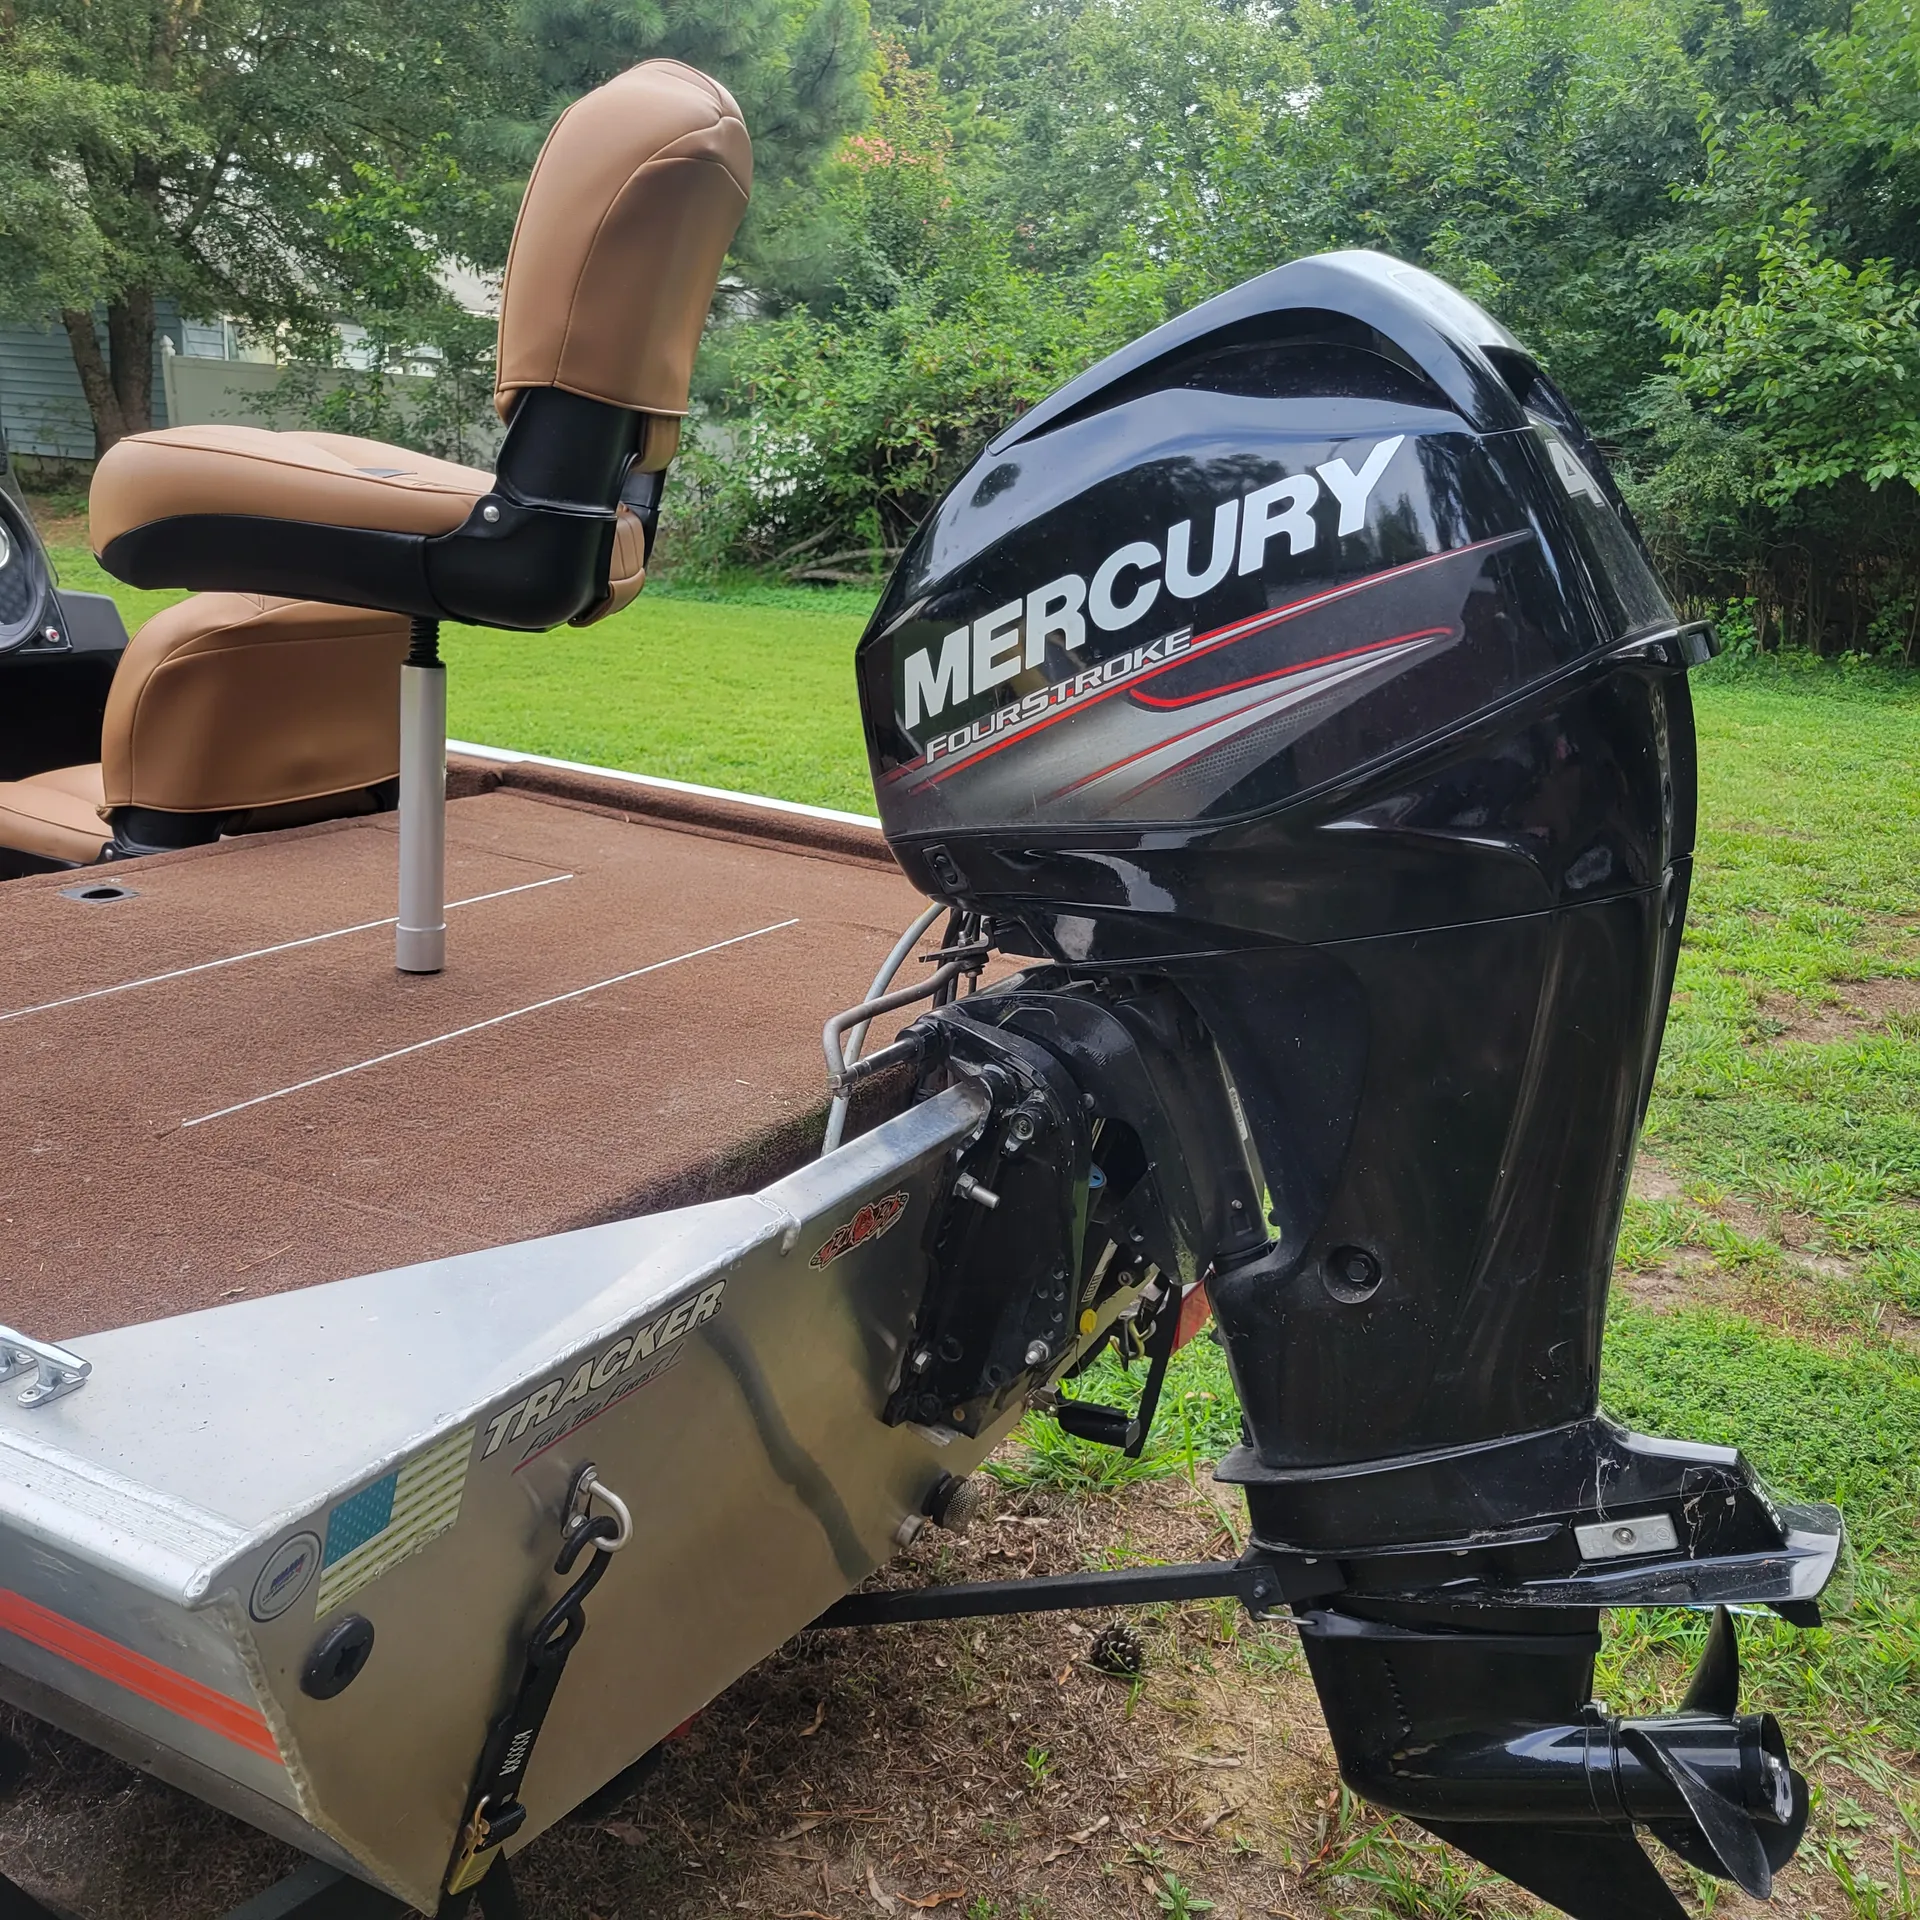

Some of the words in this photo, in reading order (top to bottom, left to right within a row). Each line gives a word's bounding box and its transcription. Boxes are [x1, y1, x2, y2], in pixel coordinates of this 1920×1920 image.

[904, 434, 1405, 730] MERCURY
[926, 626, 1192, 764] FOURSTROKE
[480, 1279, 727, 1462] TRACKER
[521, 1419, 569, 1461] Fish
[571, 1401, 603, 1428] the
